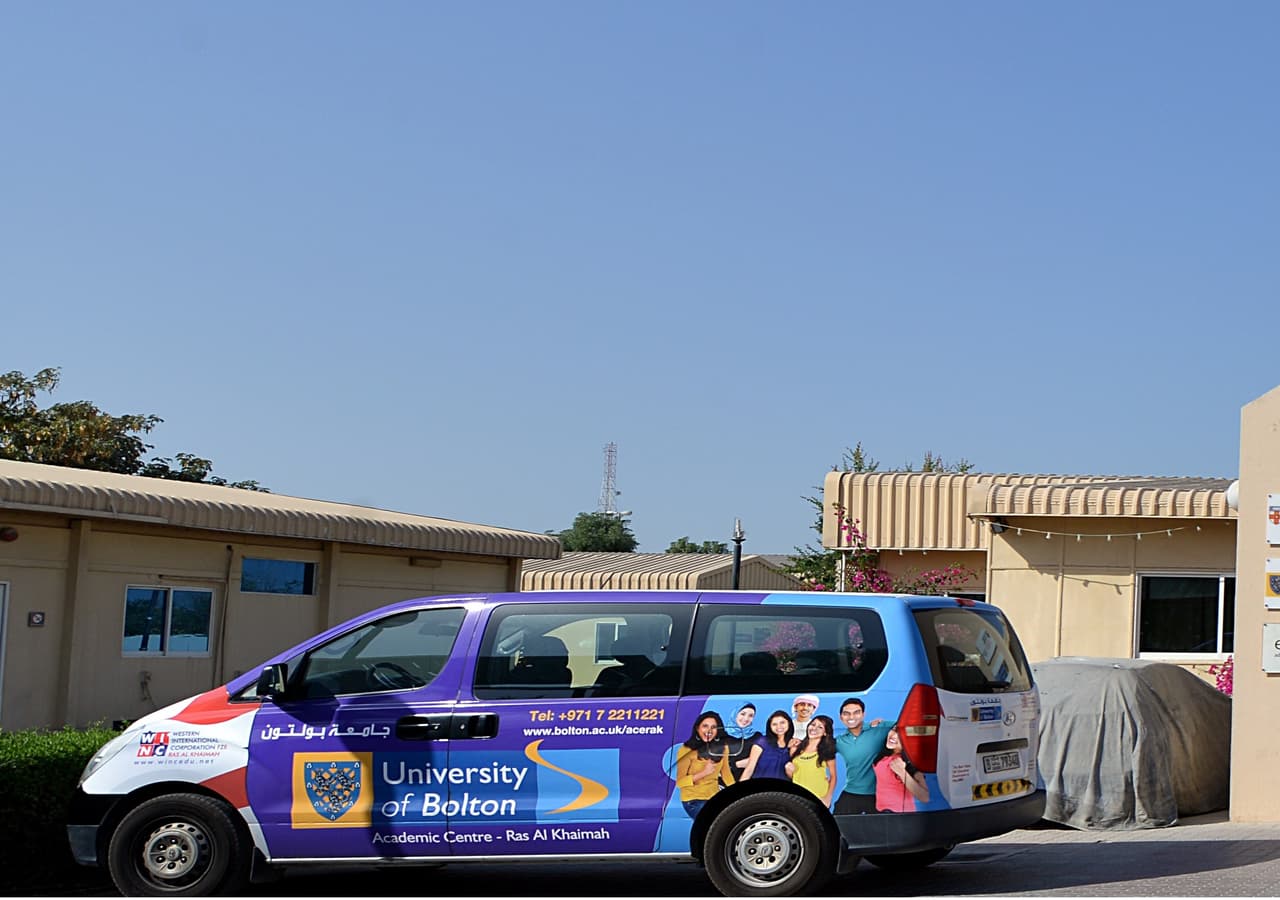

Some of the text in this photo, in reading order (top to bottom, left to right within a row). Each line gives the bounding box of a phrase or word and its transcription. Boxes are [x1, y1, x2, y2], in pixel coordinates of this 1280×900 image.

[529, 708, 665, 722] Tel: +971 7 2211221
[261, 724, 390, 740] جامعة بولتون
[523, 725, 664, 737] www.bolton.ac.uk/acerak
[382, 761, 528, 790] University
[381, 793, 517, 817] of Bolton
[372, 831, 441, 844] Academic
[444, 830, 493, 844] Centre
[506, 829, 530, 841] Ras
[533, 828, 548, 841] Al
[551, 827, 611, 841] Khaimah
